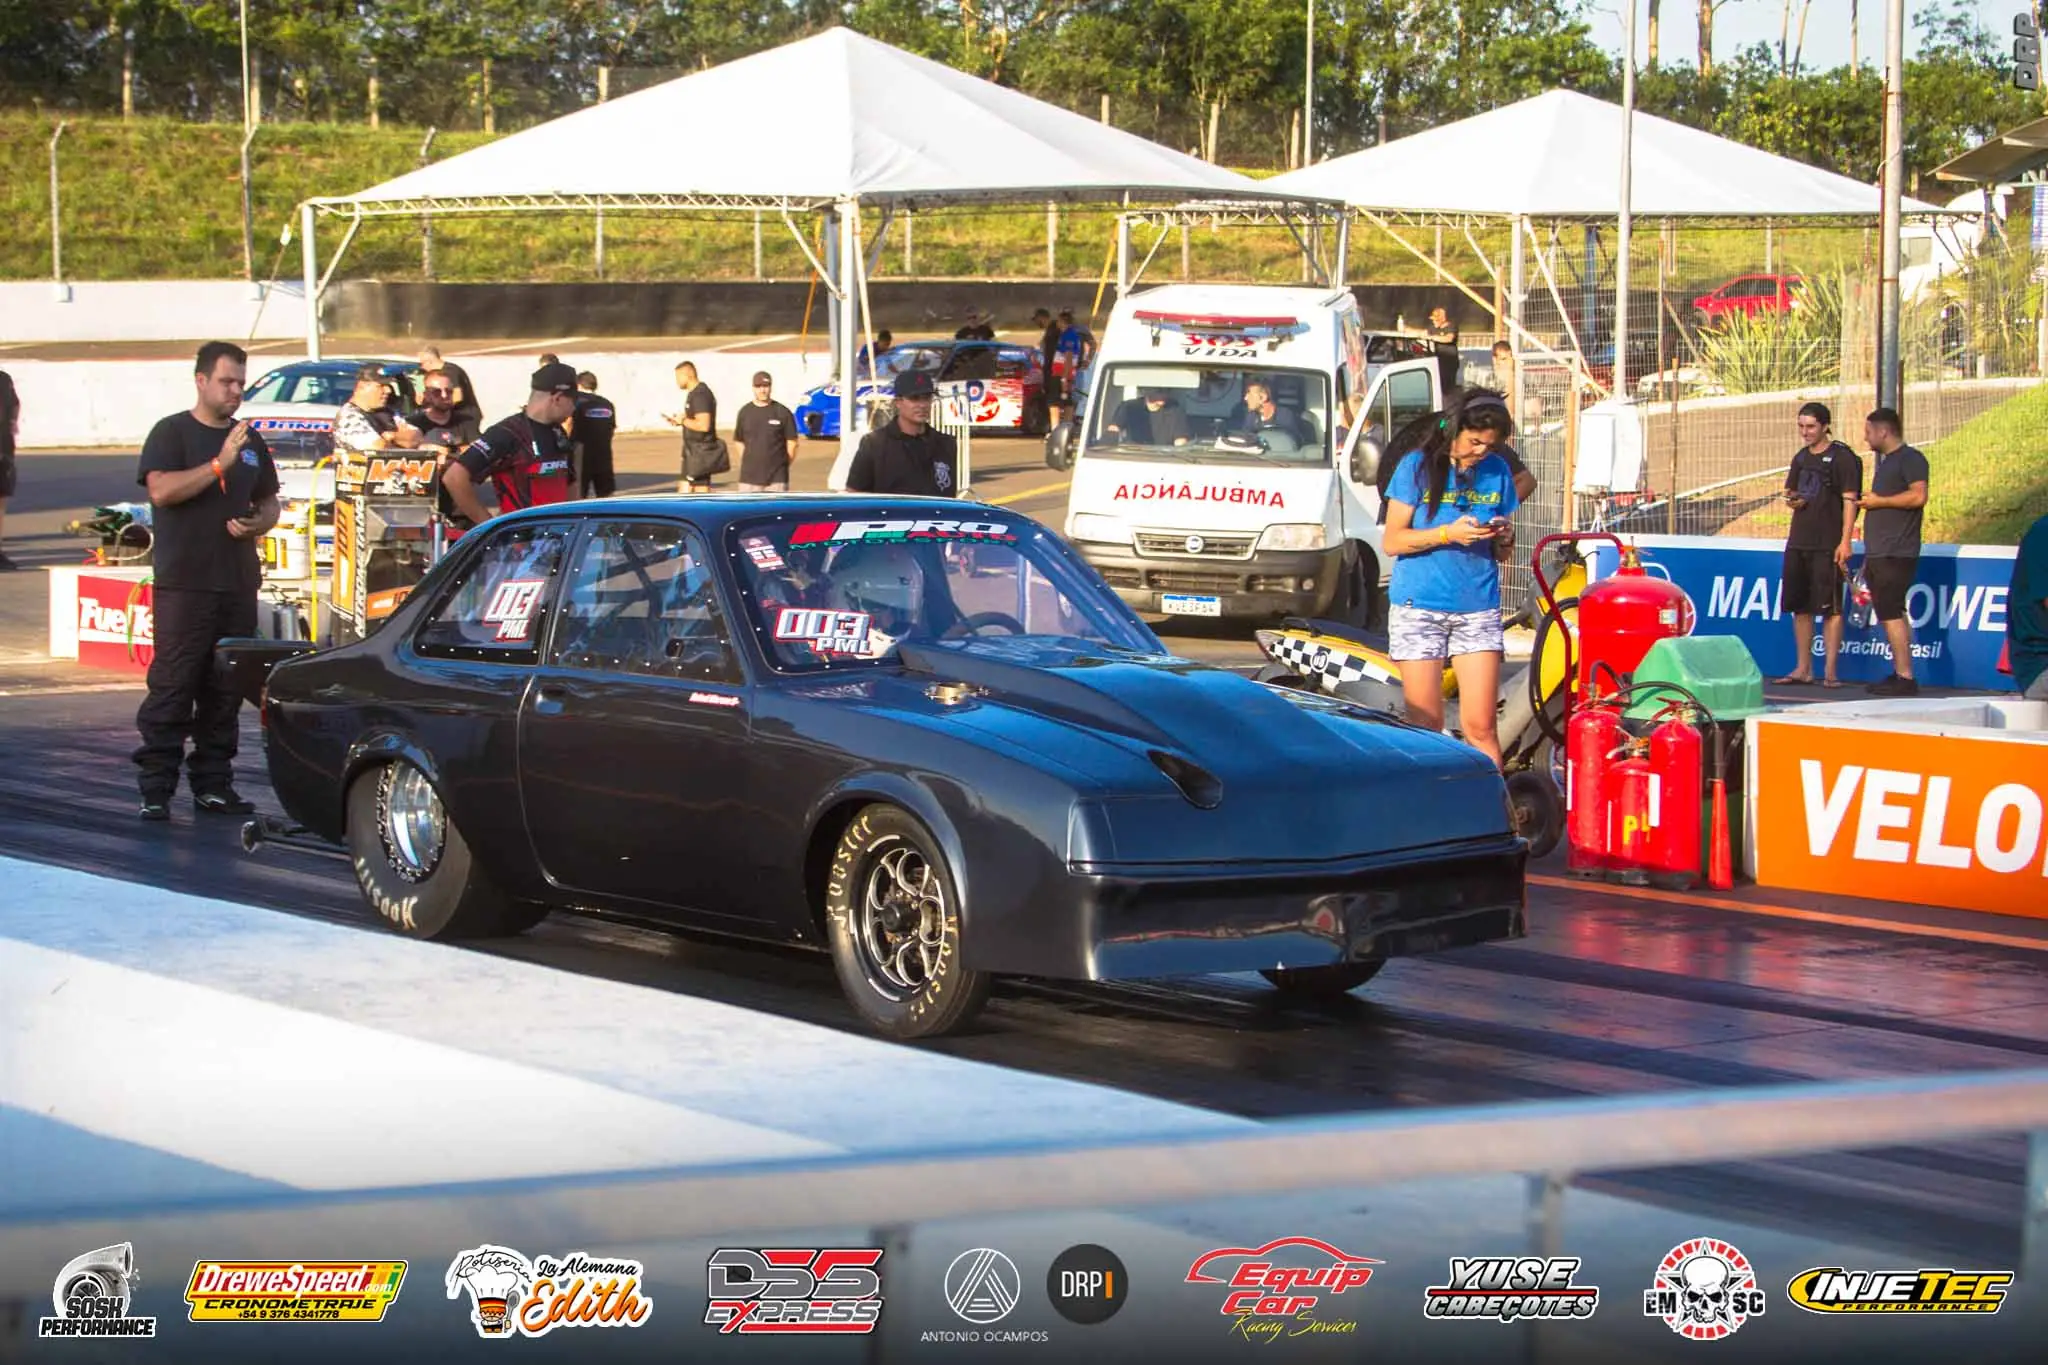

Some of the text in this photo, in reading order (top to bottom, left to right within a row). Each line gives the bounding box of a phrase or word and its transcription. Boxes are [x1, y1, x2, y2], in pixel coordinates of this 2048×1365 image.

[1184, 347, 1257, 358] VIDA
[831, 520, 1009, 540] PRO
[484, 581, 544, 621] 003
[776, 608, 869, 639] 003
[816, 637, 872, 654] PML
